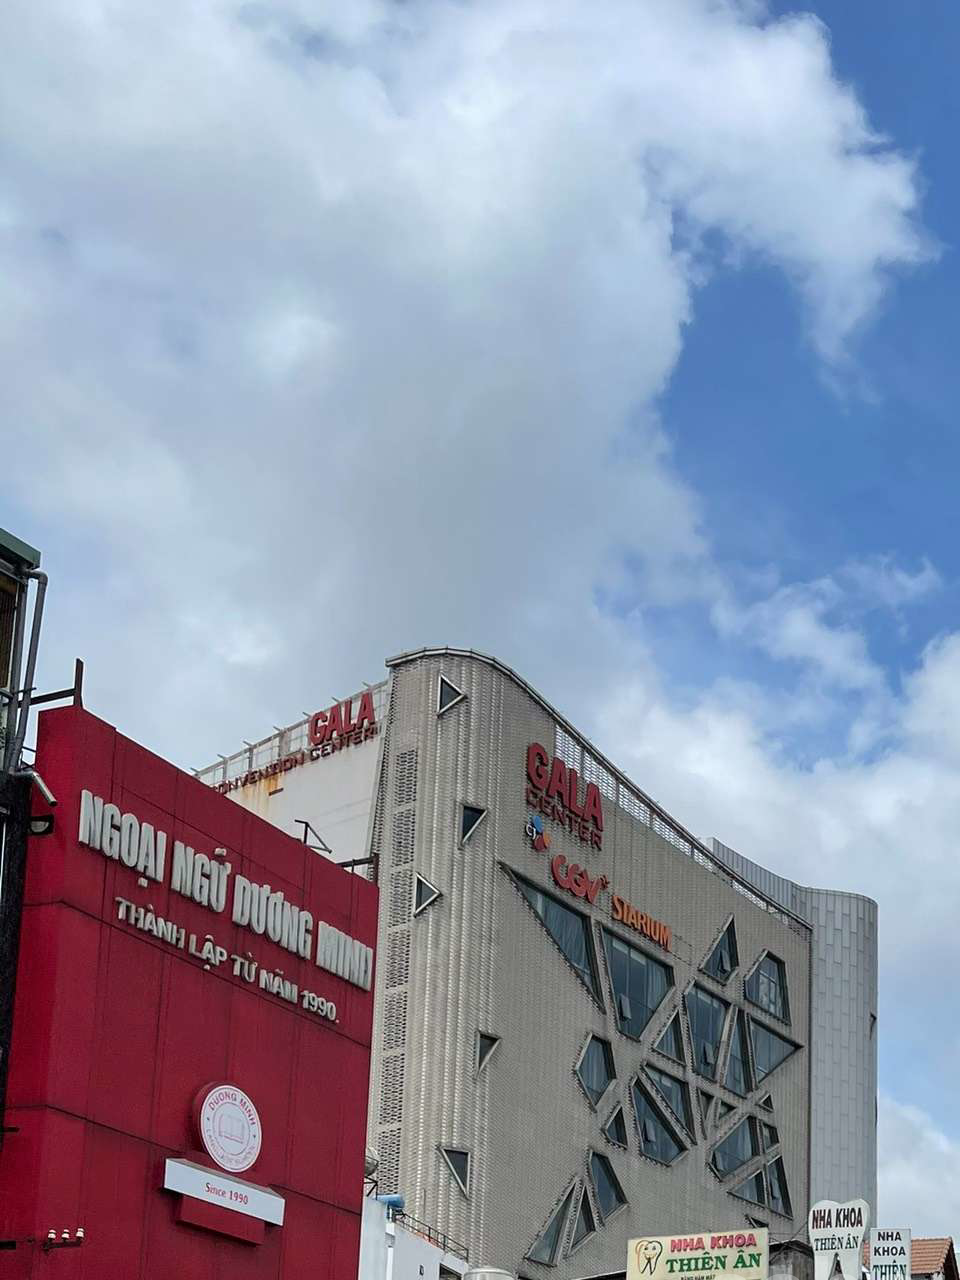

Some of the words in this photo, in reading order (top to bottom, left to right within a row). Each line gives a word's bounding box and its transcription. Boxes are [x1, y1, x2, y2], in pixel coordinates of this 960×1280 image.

[308, 691, 375, 746] GALA
[213, 751, 305, 795] ONVENTION
[527, 742, 603, 832] GALA
[526, 787, 602, 851] CENTER
[78, 788, 167, 887] NGOẠI
[171, 840, 231, 913] NGỮ
[232, 874, 313, 960] DƯƠNG
[315, 920, 374, 992] MINH
[612, 895, 672, 951] STARIUM
[115, 896, 186, 949] THÀNH
[189, 934, 227, 970] LẬP
[231, 951, 258, 983] TỪ
[259, 968, 298, 1004] NĂM
[205, 1182, 226, 1198] Since
[229, 1190, 249, 1205] 1990
[812, 1209, 832, 1229] NHA
[835, 1207, 863, 1228] KHOA
[670, 1238, 705, 1252] NHA
[710, 1234, 757, 1249] KHOA
[814, 1234, 844, 1251] THIÊN
[845, 1233, 859, 1249] ÂN
[873, 1246, 906, 1256] KHOA
[877, 1231, 902, 1241] NHA
[666, 1252, 728, 1273] THIÊN
[733, 1250, 762, 1269] ÂN
